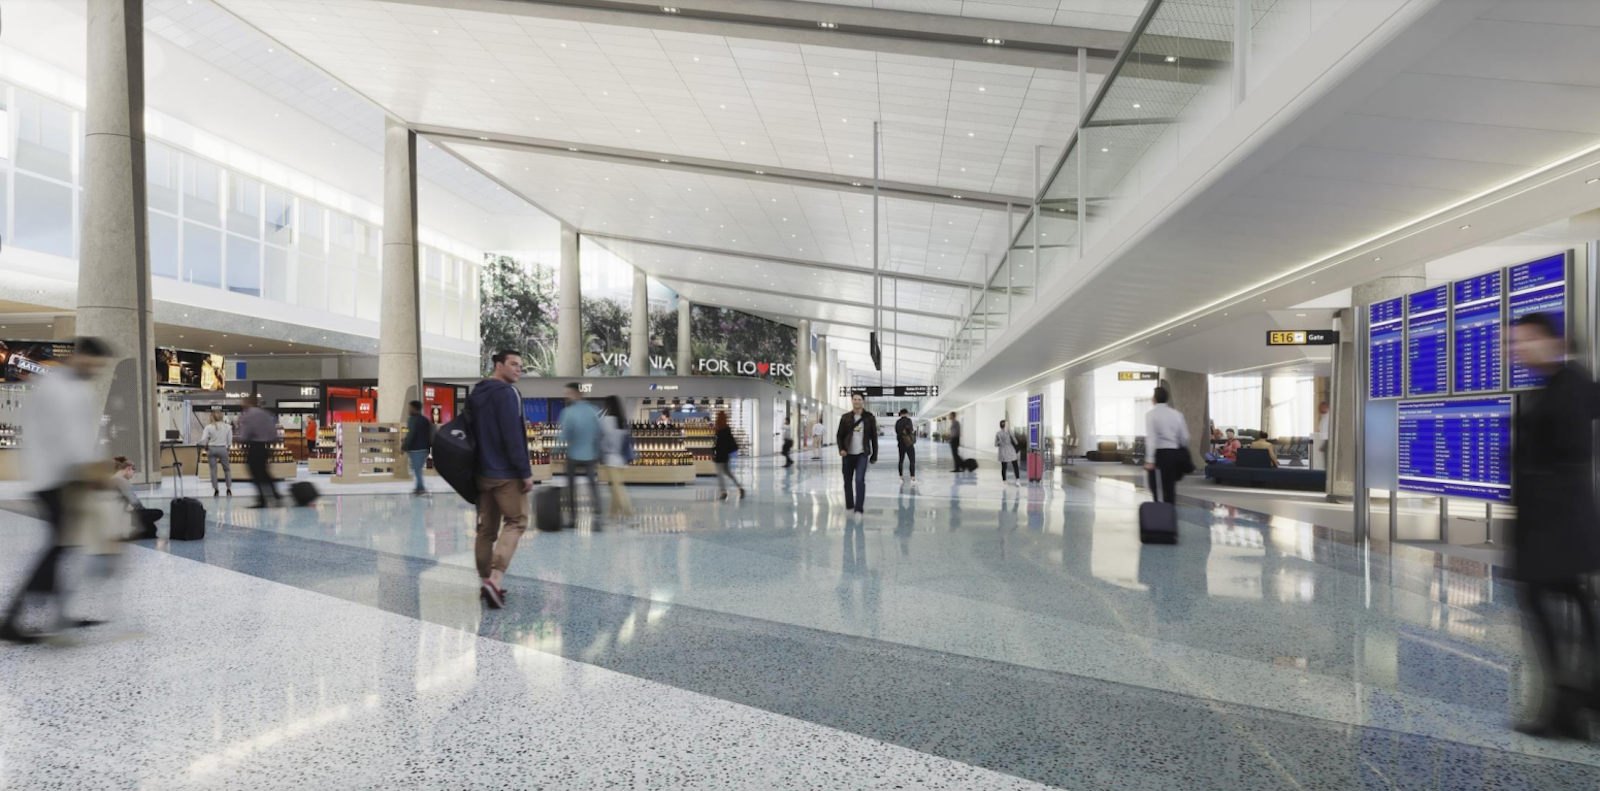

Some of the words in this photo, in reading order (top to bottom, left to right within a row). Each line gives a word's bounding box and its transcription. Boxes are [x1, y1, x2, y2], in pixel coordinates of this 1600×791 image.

[1272, 332, 1293, 343] E16
[600, 352, 675, 370] VIRNIA
[699, 358, 731, 373] FOR
